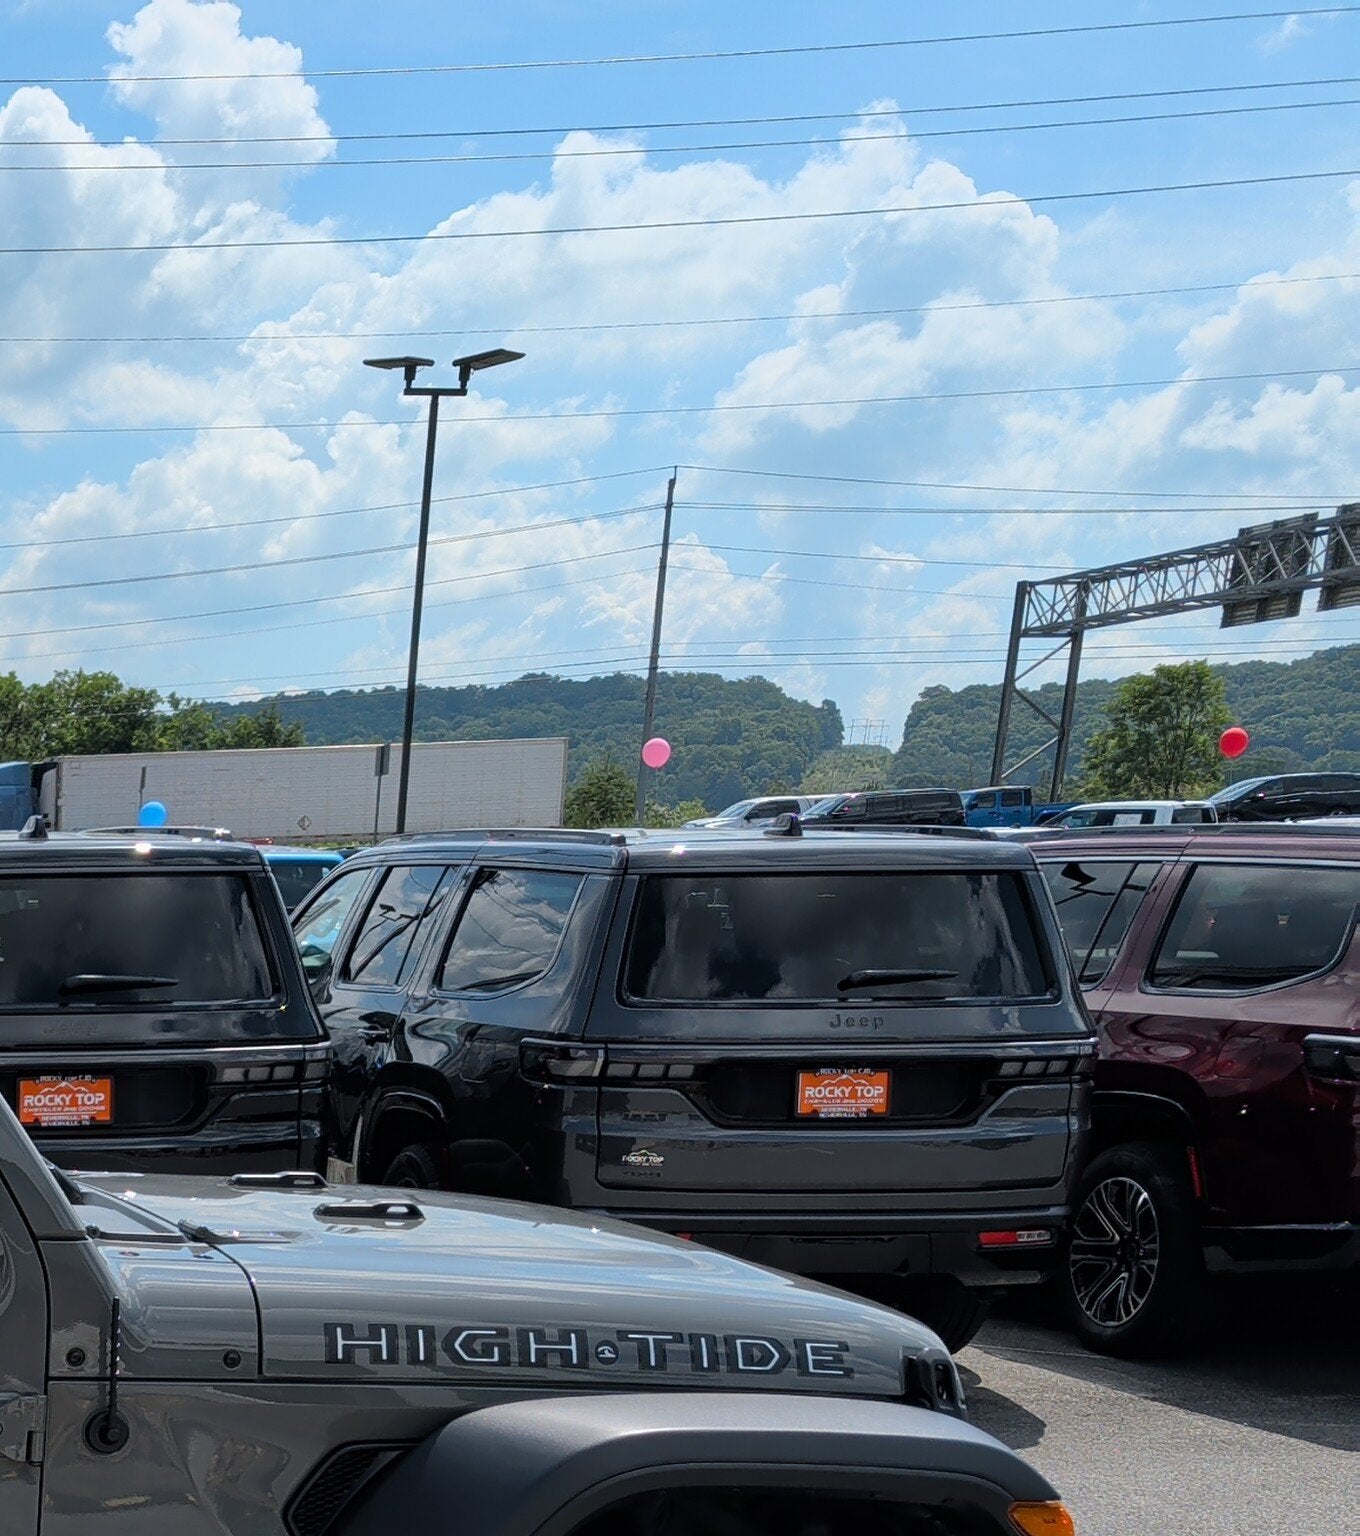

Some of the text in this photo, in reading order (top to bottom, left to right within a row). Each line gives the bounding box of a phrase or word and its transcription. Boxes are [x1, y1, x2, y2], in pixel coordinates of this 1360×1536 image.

[829, 1013, 884, 1030] Jeep
[23, 1092, 105, 1106] ROCKY TOP
[805, 1086, 884, 1098] ROCKY TOP
[648, 1155, 665, 1163] TOP
[324, 1323, 855, 1378] HIGH TIDE
